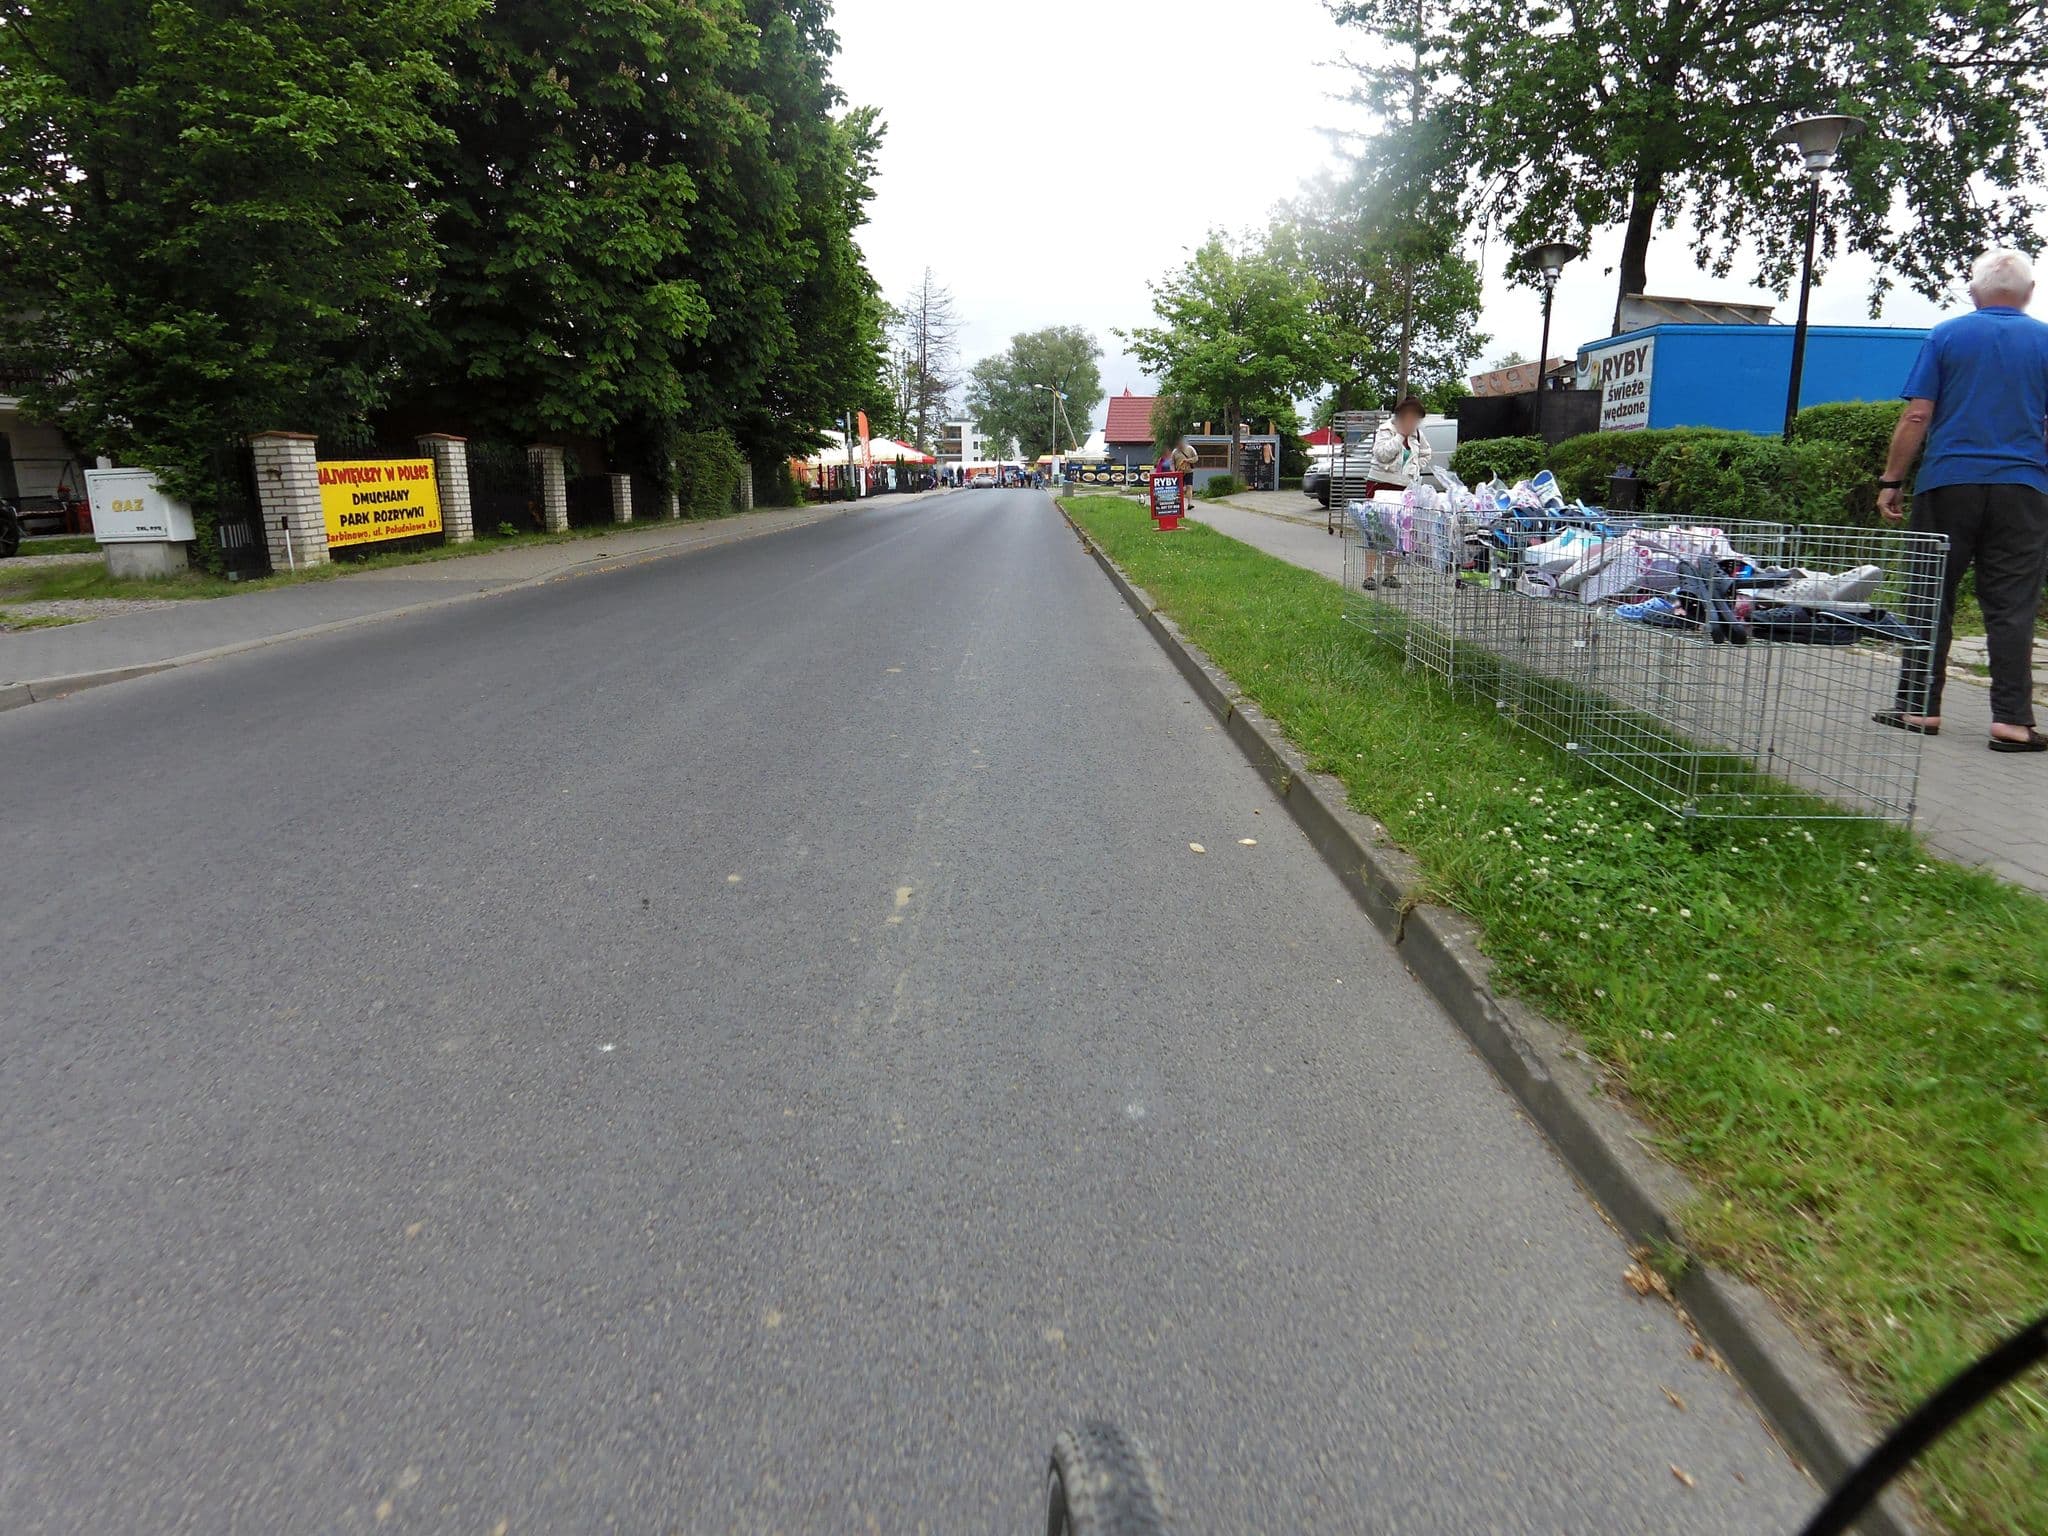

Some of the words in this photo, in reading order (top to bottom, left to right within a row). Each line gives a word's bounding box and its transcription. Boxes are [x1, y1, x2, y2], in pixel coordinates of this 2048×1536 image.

[1602, 345, 1648, 384] RYBY
[1608, 380, 1644, 402] świeże
[1604, 401, 1645, 421] wędzone
[385, 466, 395, 481] W
[397, 465, 429, 481] POLSCE
[1154, 477, 1177, 486] RYBY
[112, 499, 144, 512] GAZ
[352, 490, 410, 506] DMUCHANY
[340, 511, 370, 527] PARK
[373, 506, 425, 523] ROZRYWKI
[373, 527, 383, 536] ul.
